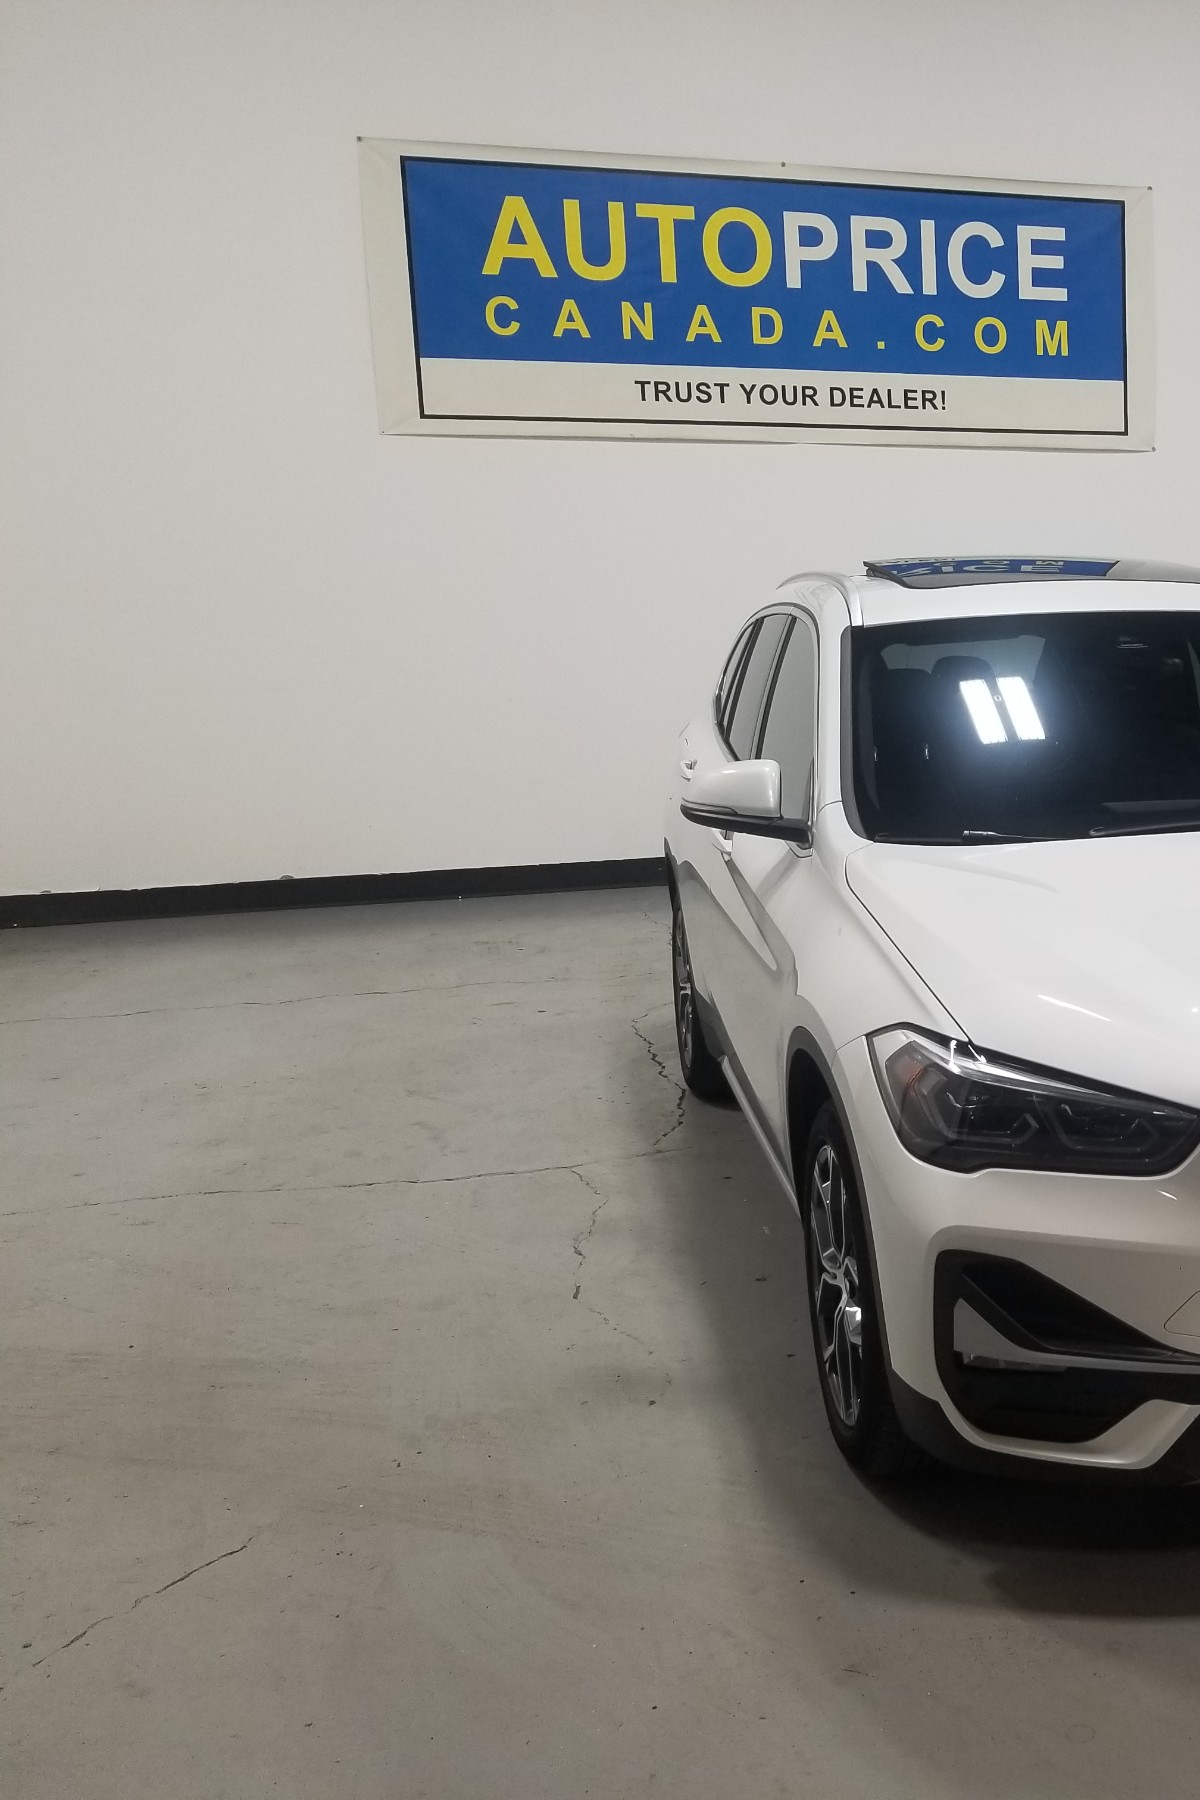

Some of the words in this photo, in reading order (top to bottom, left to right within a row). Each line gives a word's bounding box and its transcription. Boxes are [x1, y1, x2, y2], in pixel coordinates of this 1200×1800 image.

[482, 196, 1068, 301] AUTOPRICE
[485, 296, 1069, 356] CANADA.COM
[635, 380, 730, 403] TRUST
[739, 384, 820, 406] YOUR
[830, 387, 946, 410] DEALER!
